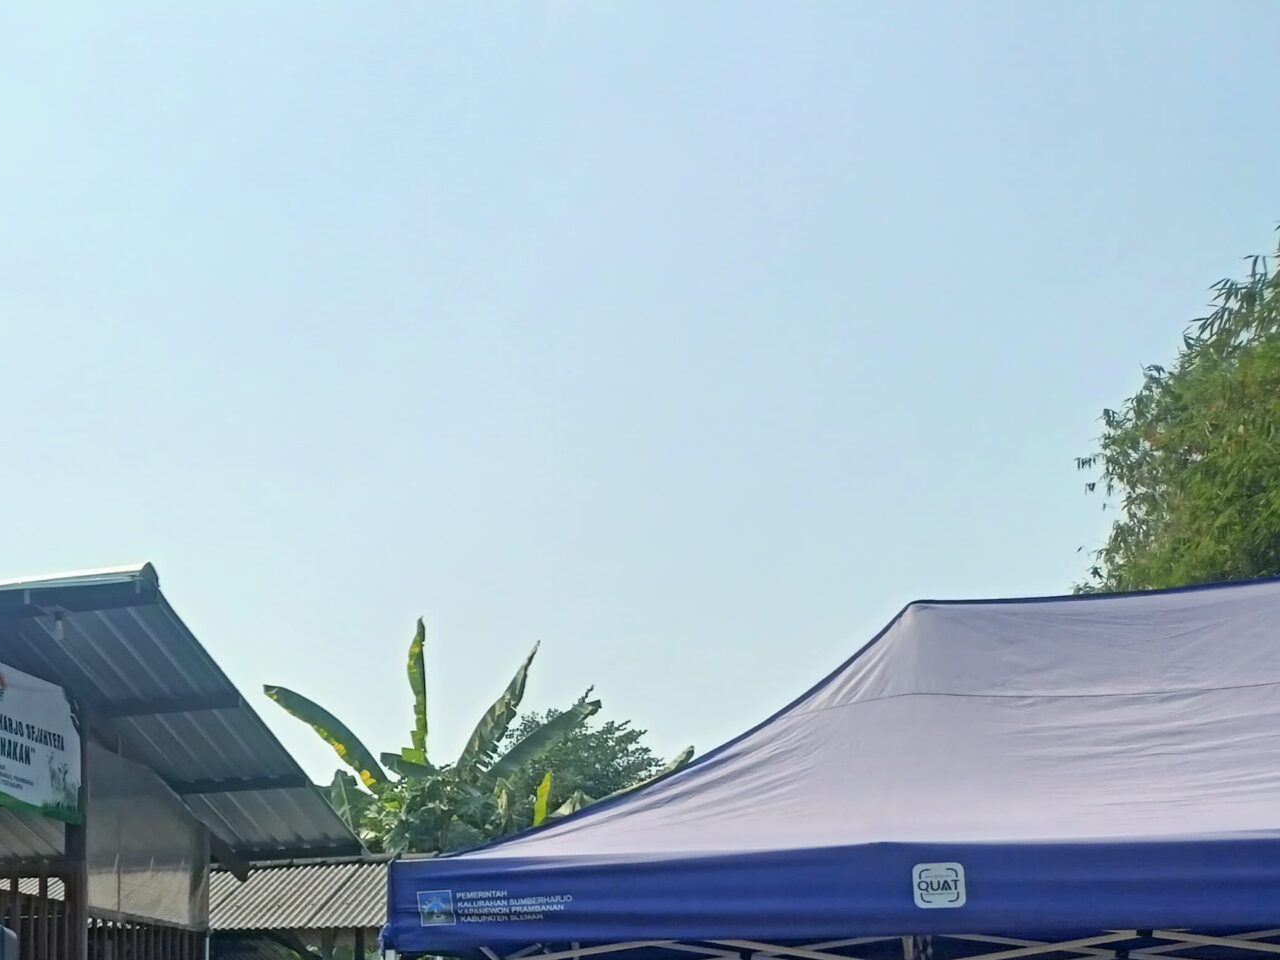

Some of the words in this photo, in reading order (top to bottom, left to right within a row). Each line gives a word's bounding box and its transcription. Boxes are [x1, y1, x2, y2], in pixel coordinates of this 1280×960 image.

[917, 879, 960, 893] QUAT
[456, 890, 507, 899] PEMERINTAH
[457, 899, 508, 908] KALURAHAN
[509, 894, 573, 906] SUMBERHARJO
[511, 904, 565, 913] PRAMBANAN
